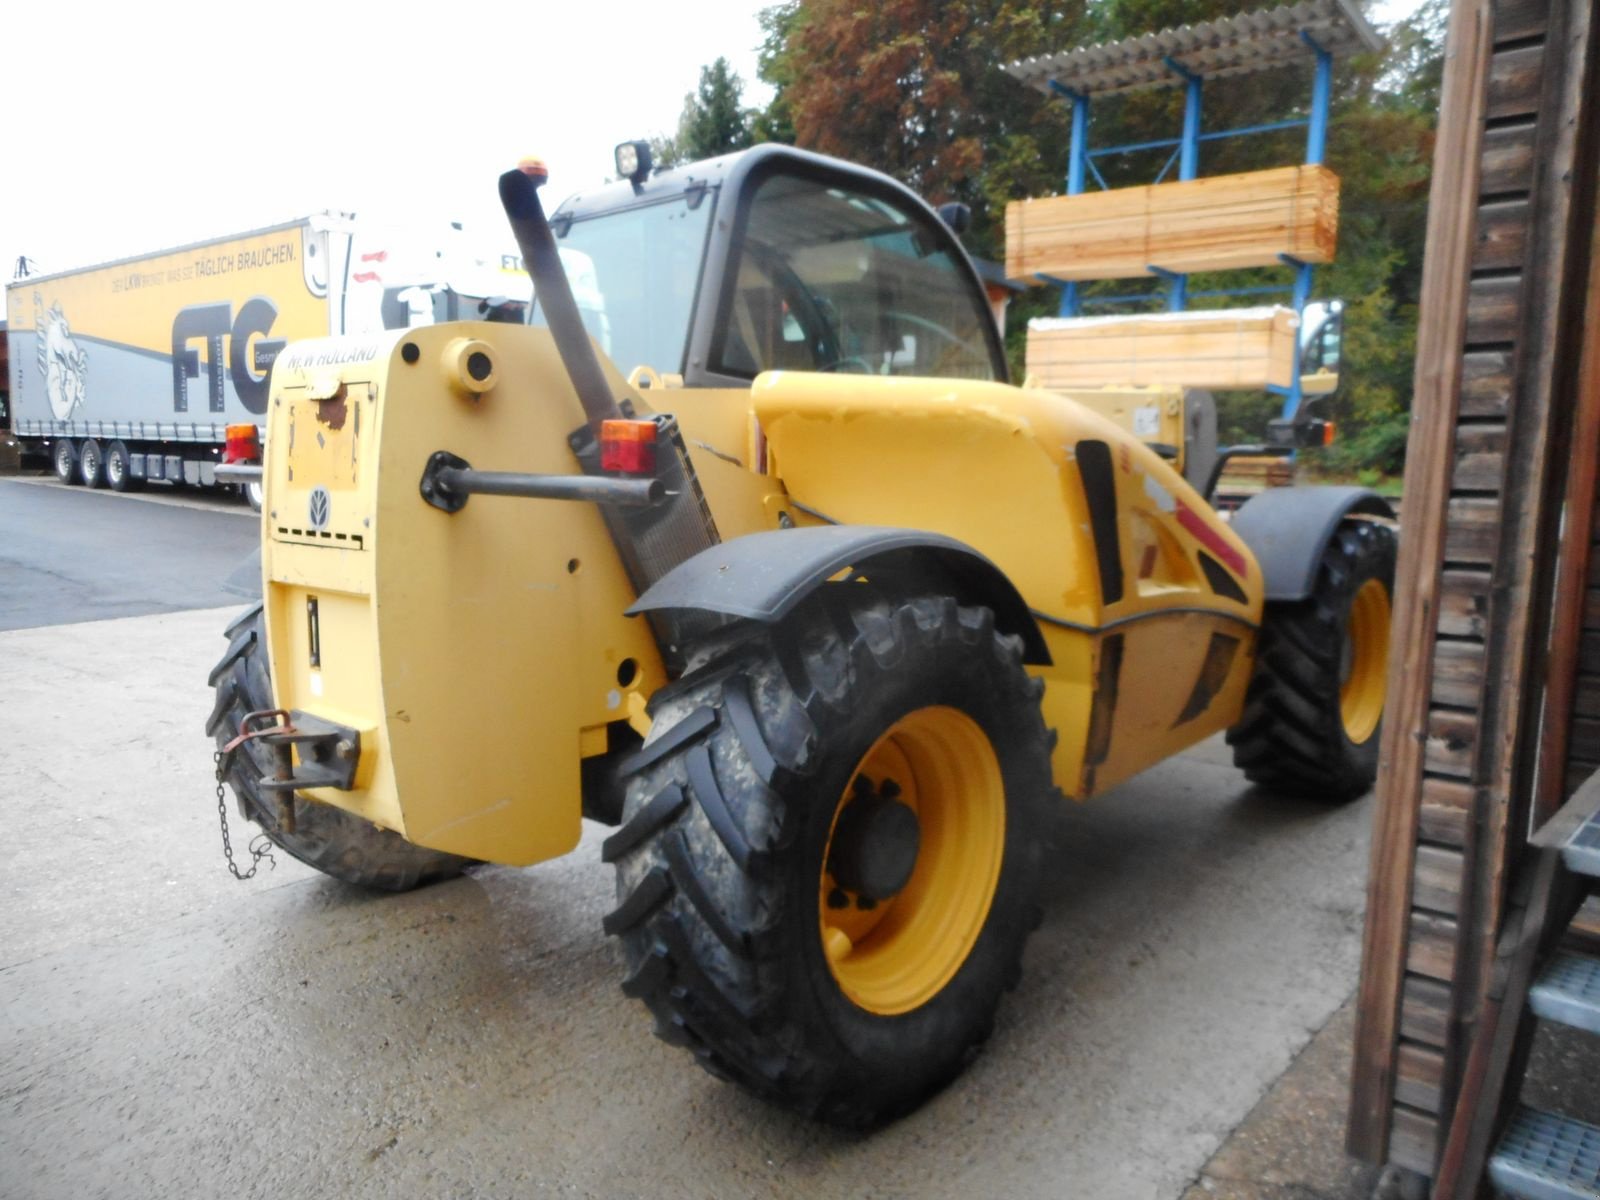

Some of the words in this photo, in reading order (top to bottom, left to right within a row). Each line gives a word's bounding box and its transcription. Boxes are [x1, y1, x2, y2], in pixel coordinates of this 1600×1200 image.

[501, 254, 527, 272] FT
[124, 273, 142, 291] LKW
[172, 296, 287, 415] FTG
[316, 345, 378, 366] HOLLAND
